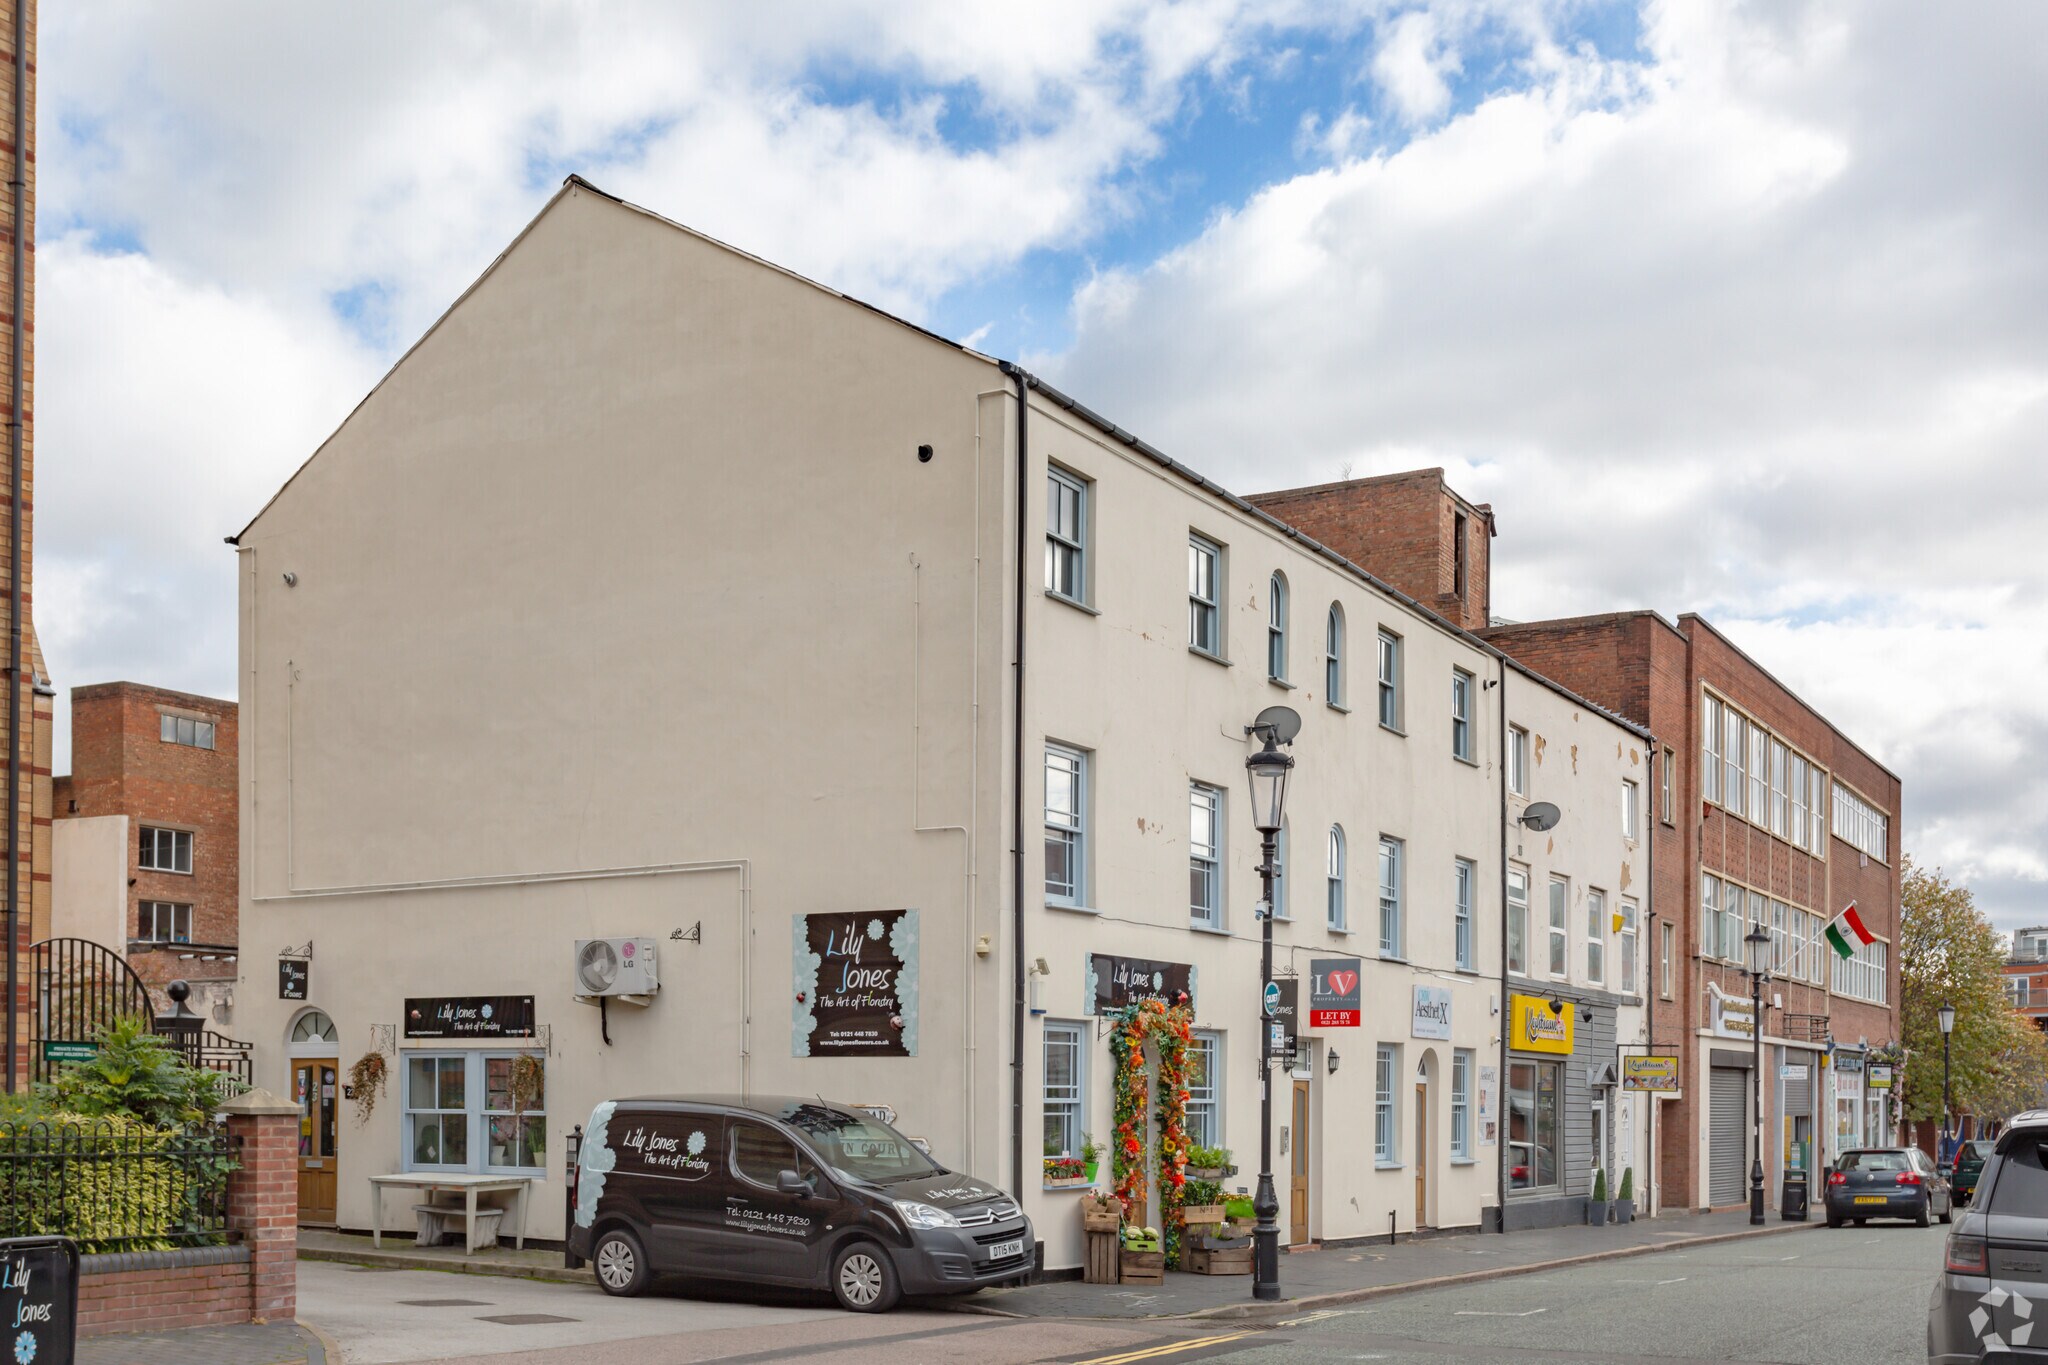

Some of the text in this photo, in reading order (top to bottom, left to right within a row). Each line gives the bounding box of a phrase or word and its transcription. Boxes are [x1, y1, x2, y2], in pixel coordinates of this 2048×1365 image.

[826, 920, 864, 965] Lily
[836, 960, 892, 994] Jones
[1113, 962, 1150, 991] Lily Jones
[820, 990, 894, 1010] The Art of Floristry
[1129, 990, 1138, 1003] The
[437, 1003, 477, 1022] Lily Jones
[1320, 1011, 1352, 1020] LET BY
[464, 1022, 474, 1031] Art
[474, 1021, 481, 1033] of
[623, 1126, 680, 1153] Lily Jones
[644, 1152, 709, 1172] The Art of Floristry
[726, 1207, 810, 1226] Tel: 0121 448 7830
[725, 1220, 806, 1237] www.lilyjonesflowers.co.uk
[993, 1242, 1020, 1257] DT15 KNH
[2, 1256, 31, 1295] Lily
[12, 1298, 53, 1328] Jones
